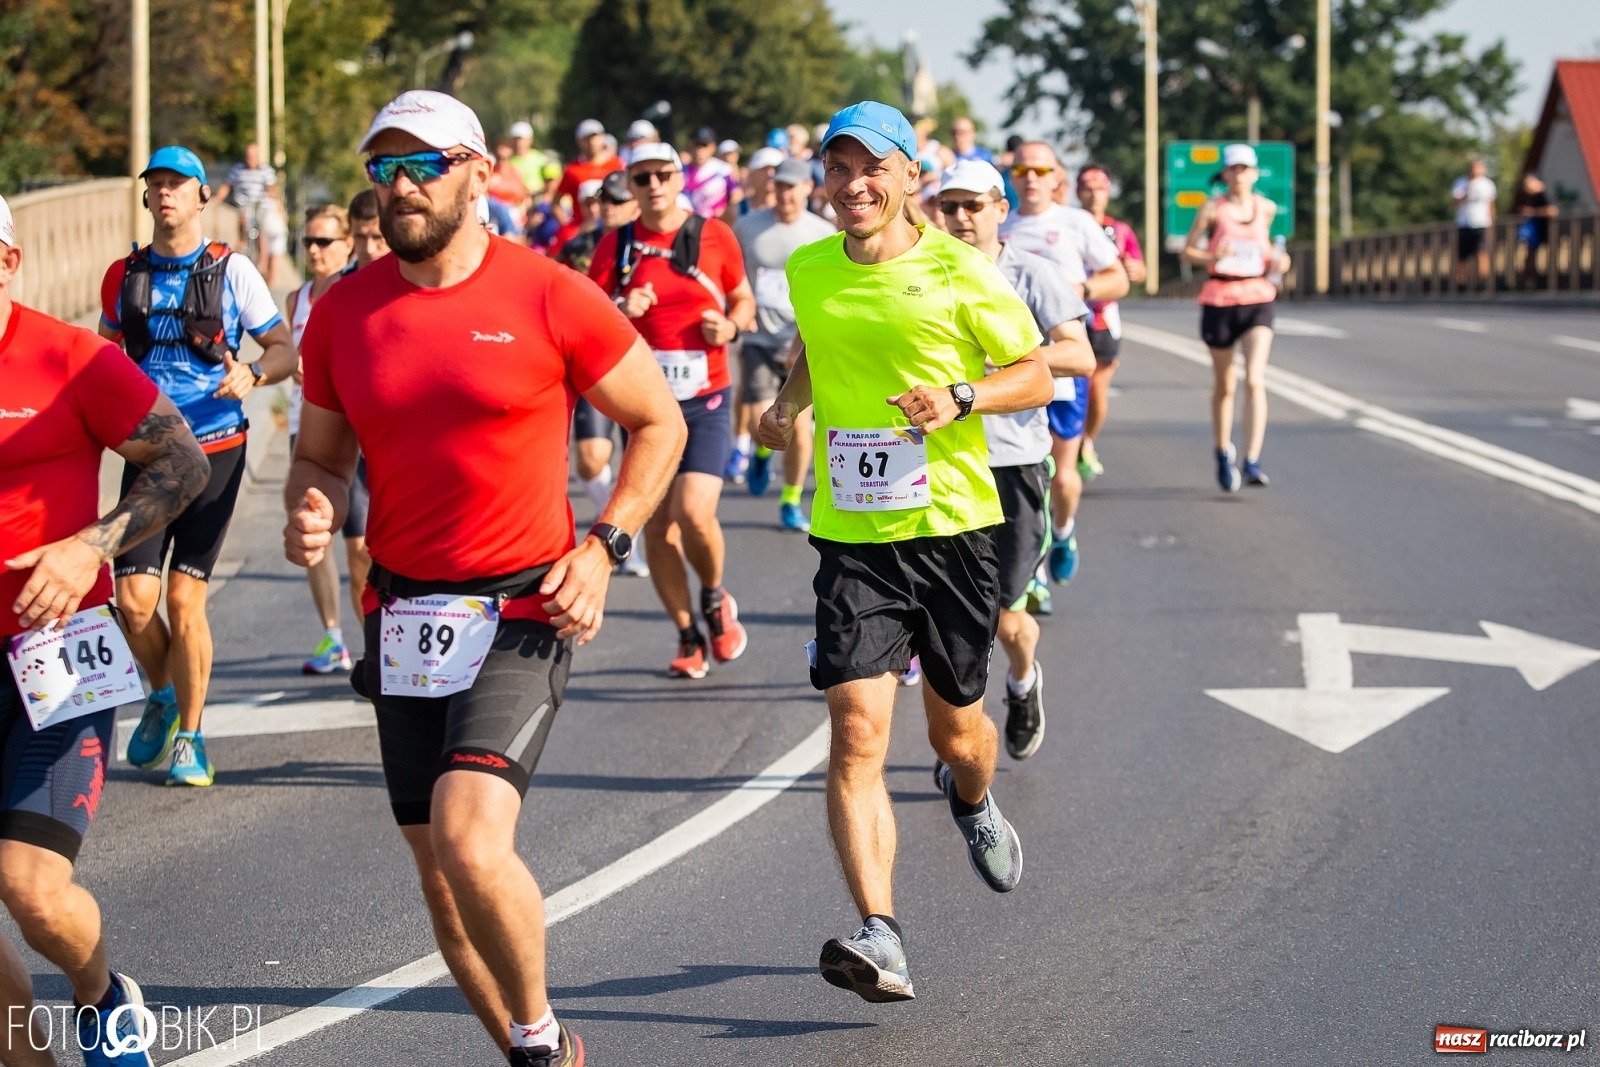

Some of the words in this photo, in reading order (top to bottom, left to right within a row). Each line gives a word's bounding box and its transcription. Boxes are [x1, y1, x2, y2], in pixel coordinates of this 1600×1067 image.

[858, 452, 889, 478] 67
[860, 480, 889, 488] SEBASTIAN
[418, 622, 454, 656] 89
[58, 634, 114, 675] 146
